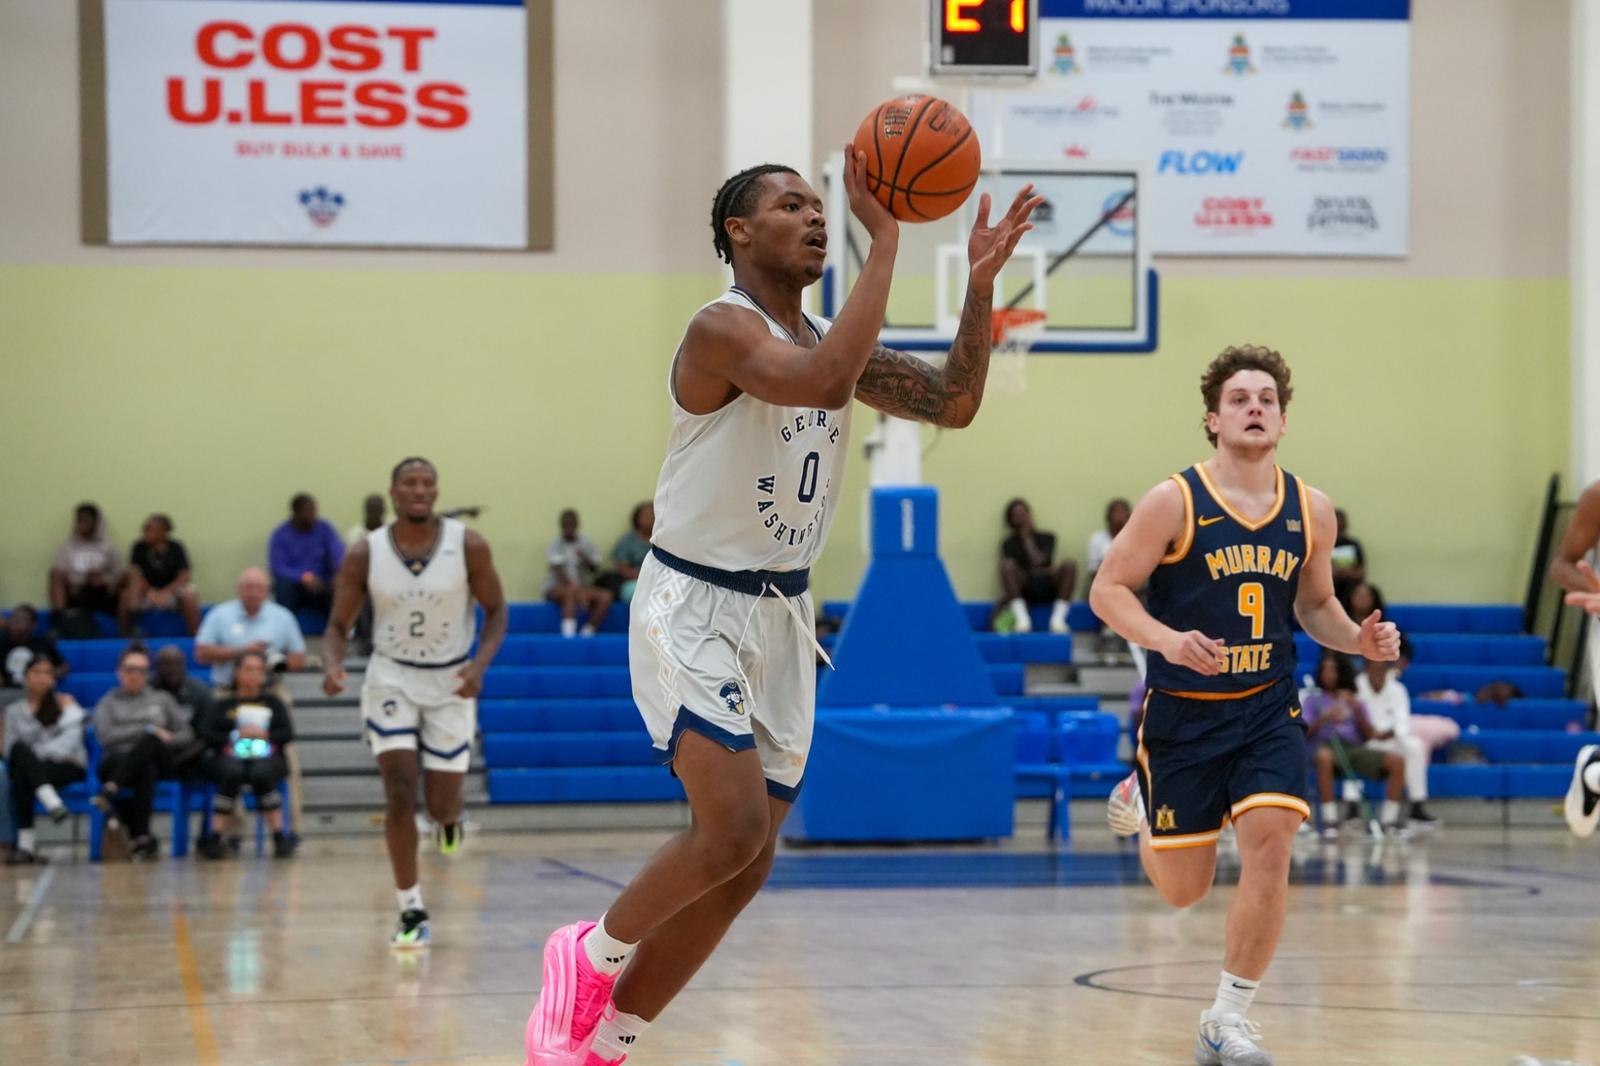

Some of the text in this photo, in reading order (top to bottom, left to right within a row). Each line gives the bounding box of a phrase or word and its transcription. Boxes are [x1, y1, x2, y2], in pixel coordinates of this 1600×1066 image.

[195, 20, 438, 73] COST
[166, 77, 471, 130] U.LESS
[235, 141, 405, 160] BUY BULK & SAVE
[1157, 149, 1245, 176] FLOW
[797, 451, 820, 503] 0
[1204, 544, 1299, 581] MURRAY
[409, 610, 426, 638] 2
[1238, 582, 1265, 639] 9
[1216, 643, 1273, 674] STATE
